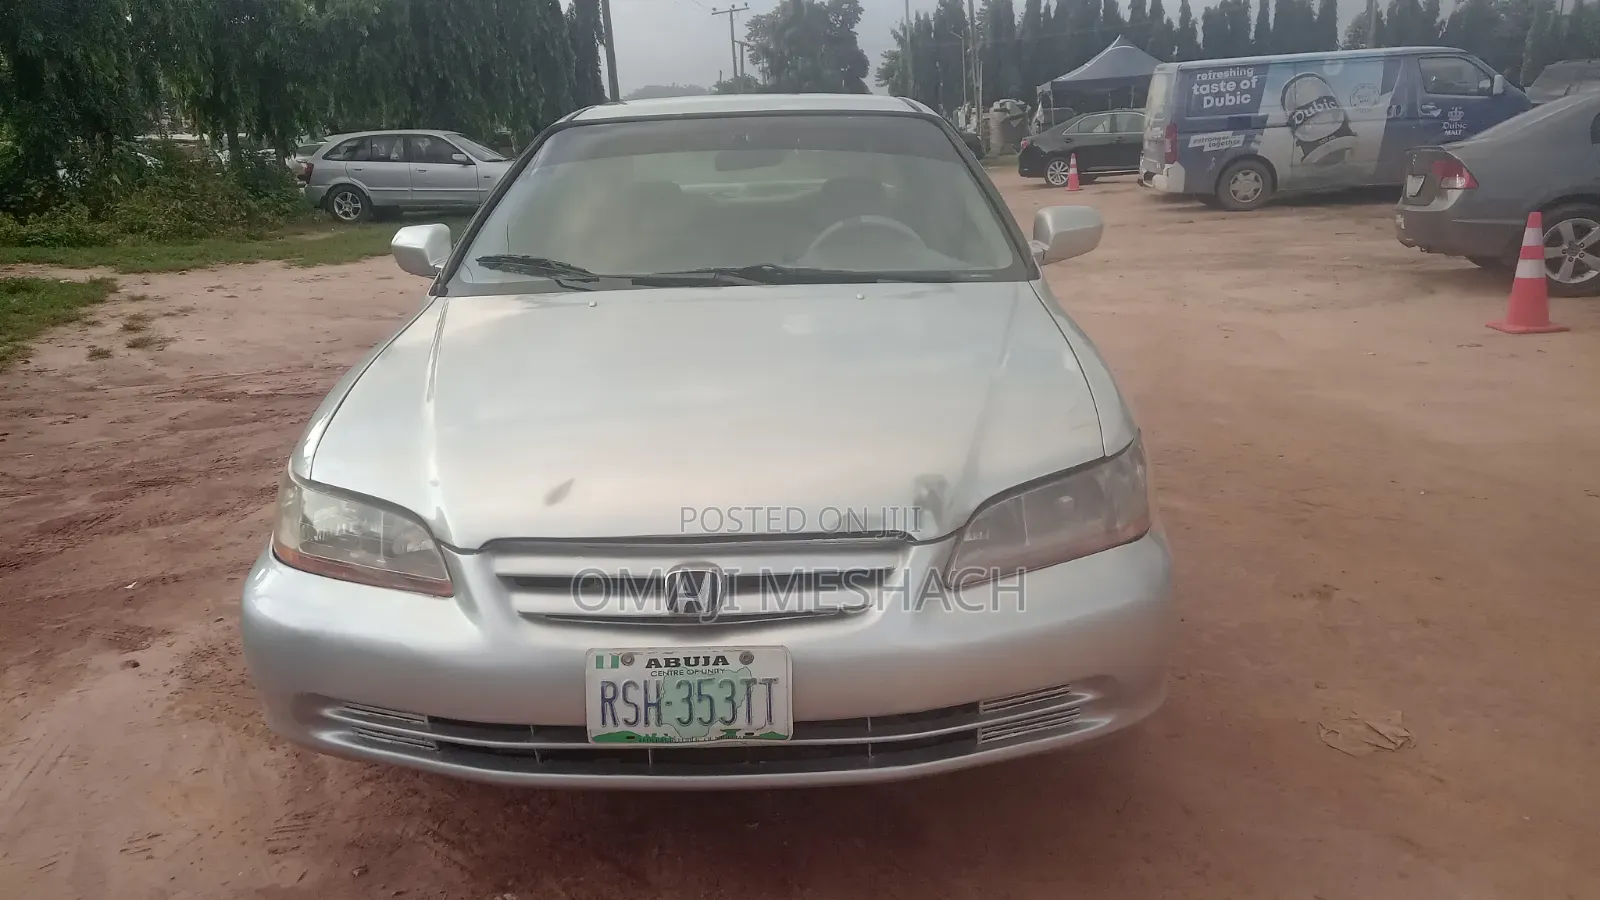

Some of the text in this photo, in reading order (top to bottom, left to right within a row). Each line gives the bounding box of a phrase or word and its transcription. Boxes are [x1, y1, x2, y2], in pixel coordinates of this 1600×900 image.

[1196, 67, 1254, 81] refreshing
[1192, 76, 1259, 95] taste of
[1203, 92, 1251, 108] Dubic
[1293, 98, 1337, 125] Dubic
[1442, 121, 1467, 130] Dubic
[645, 655, 730, 669] ABUJA
[650, 667, 725, 677] CENTRE OF UNITY
[600, 677, 780, 728] RSH-353TT
